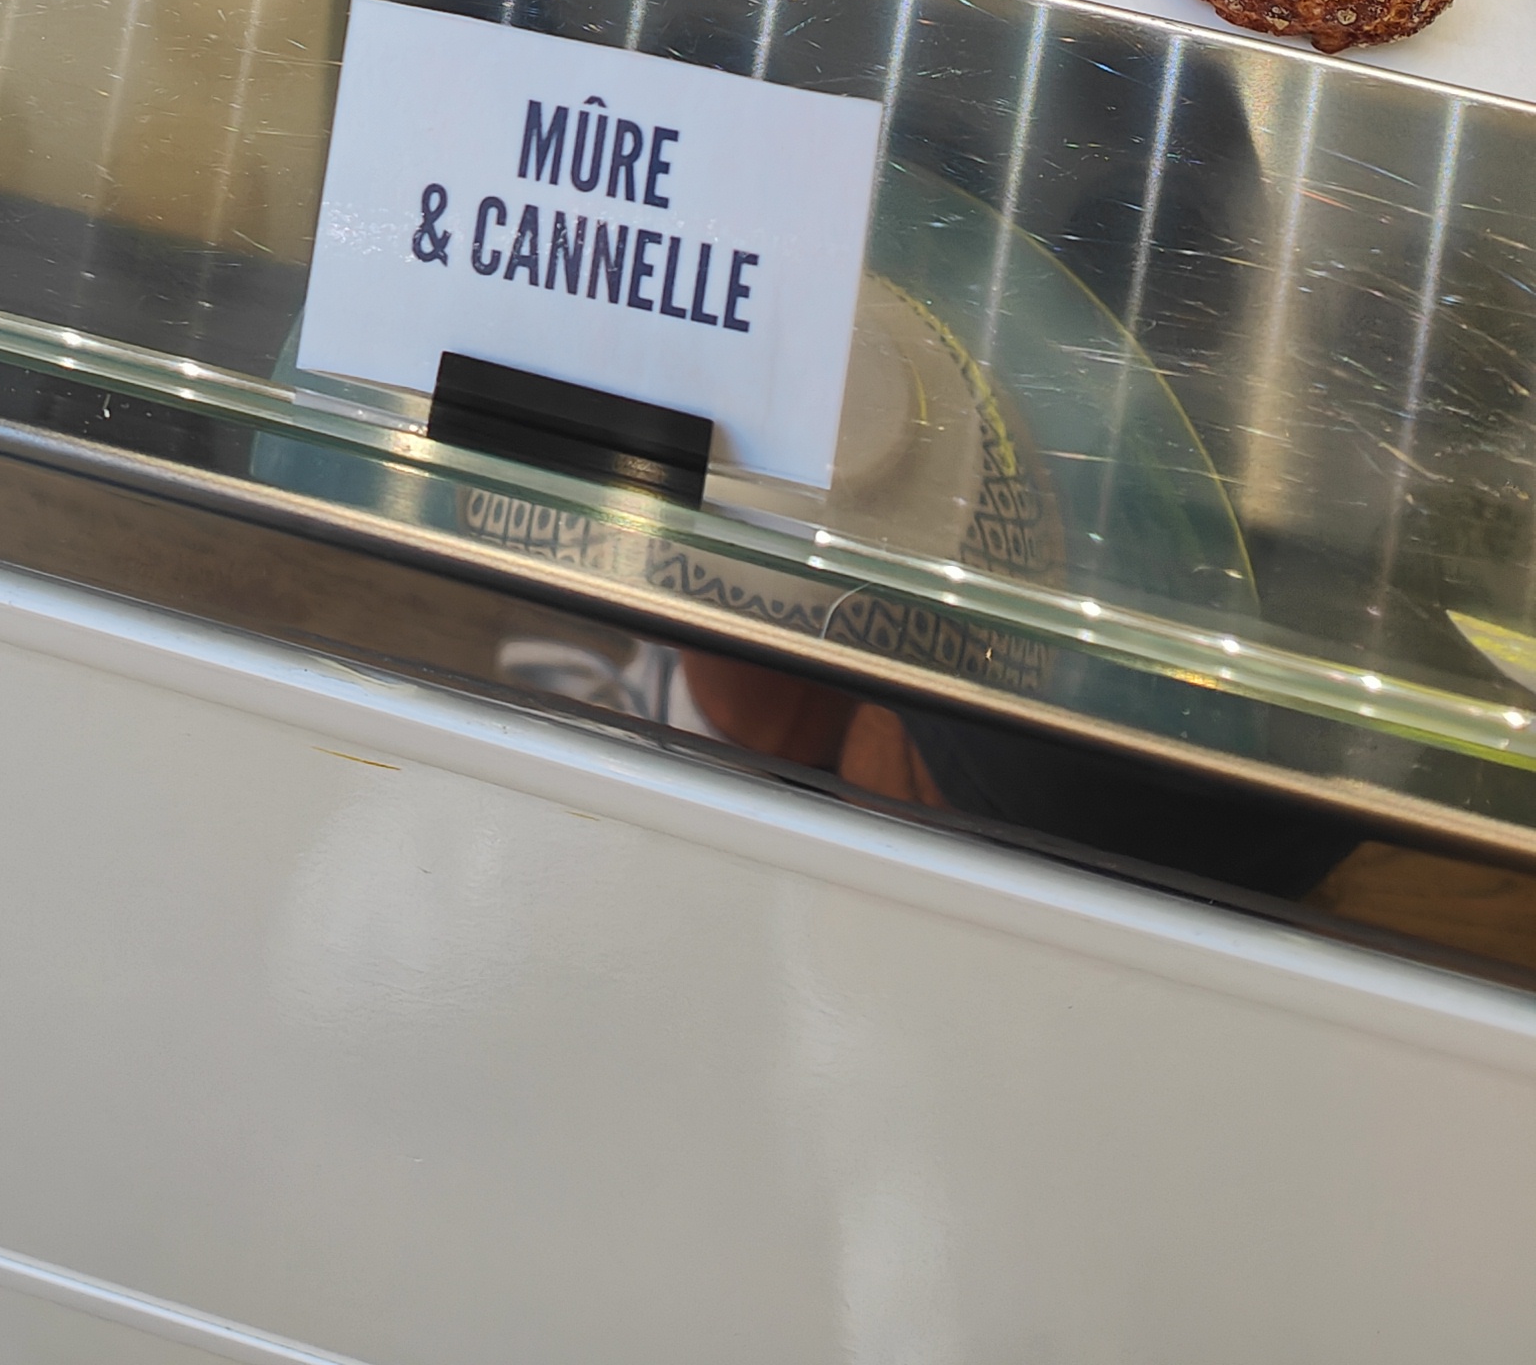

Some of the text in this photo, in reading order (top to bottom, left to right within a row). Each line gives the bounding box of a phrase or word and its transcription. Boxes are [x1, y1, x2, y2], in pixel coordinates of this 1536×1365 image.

[517, 95, 680, 210] MÛRE
[411, 183, 760, 333] & CANNELLE
